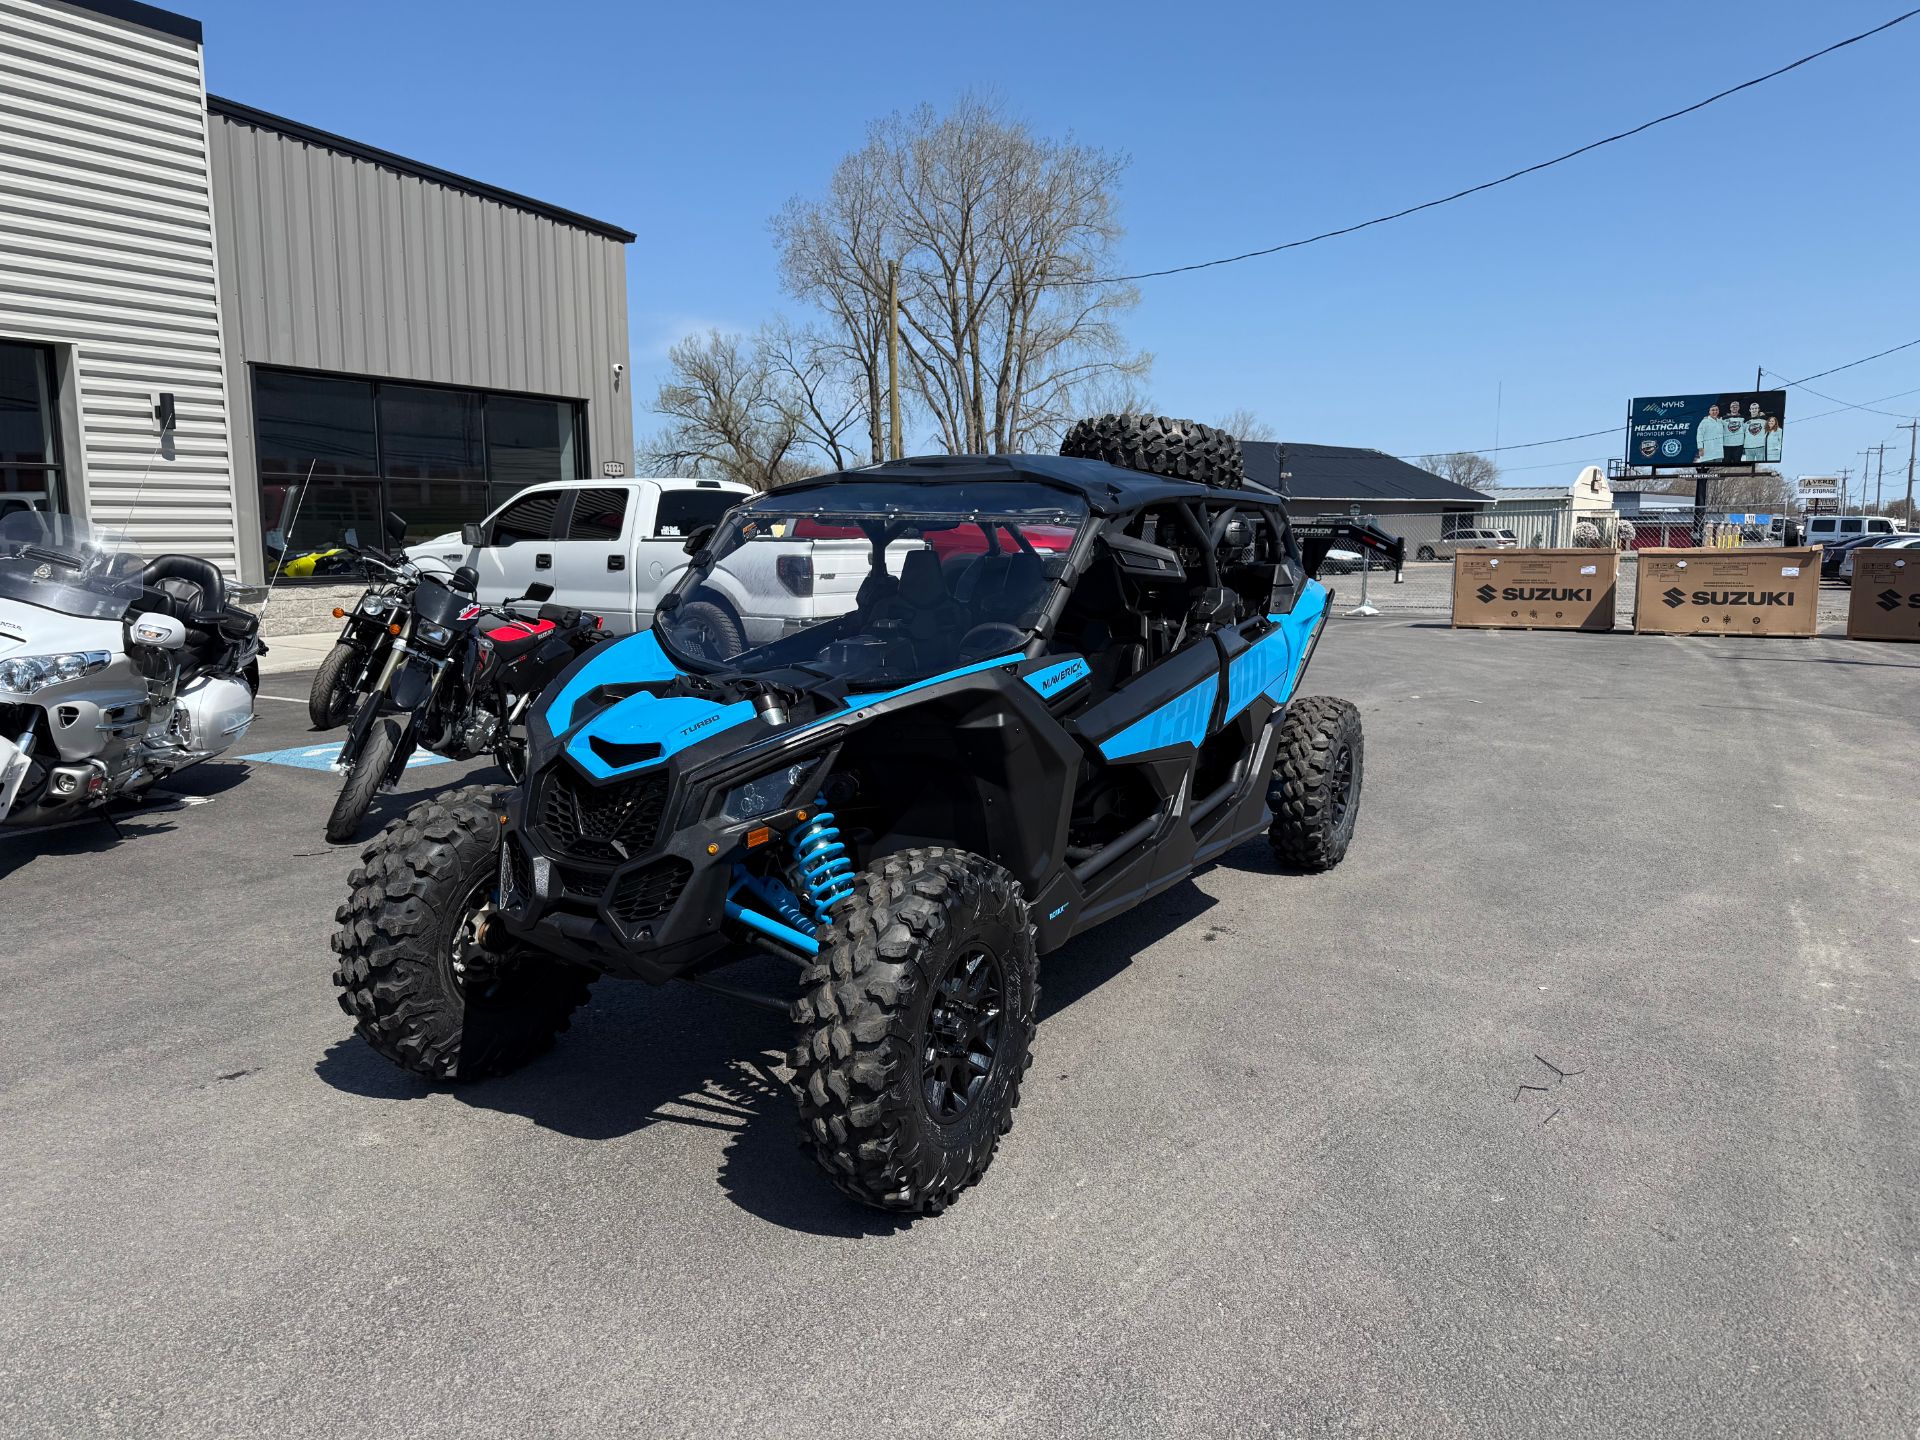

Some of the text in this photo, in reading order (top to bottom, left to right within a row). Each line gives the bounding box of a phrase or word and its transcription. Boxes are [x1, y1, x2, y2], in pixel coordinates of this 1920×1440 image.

[1634, 423, 1690, 432] HEALTHCARE
[606, 464, 622, 473] 2122
[1502, 587, 1592, 602] SUZUKI
[1691, 591, 1795, 606] SUZUKI
[1042, 660, 1082, 690] MAVERICK
[680, 714, 721, 736] TURBO
